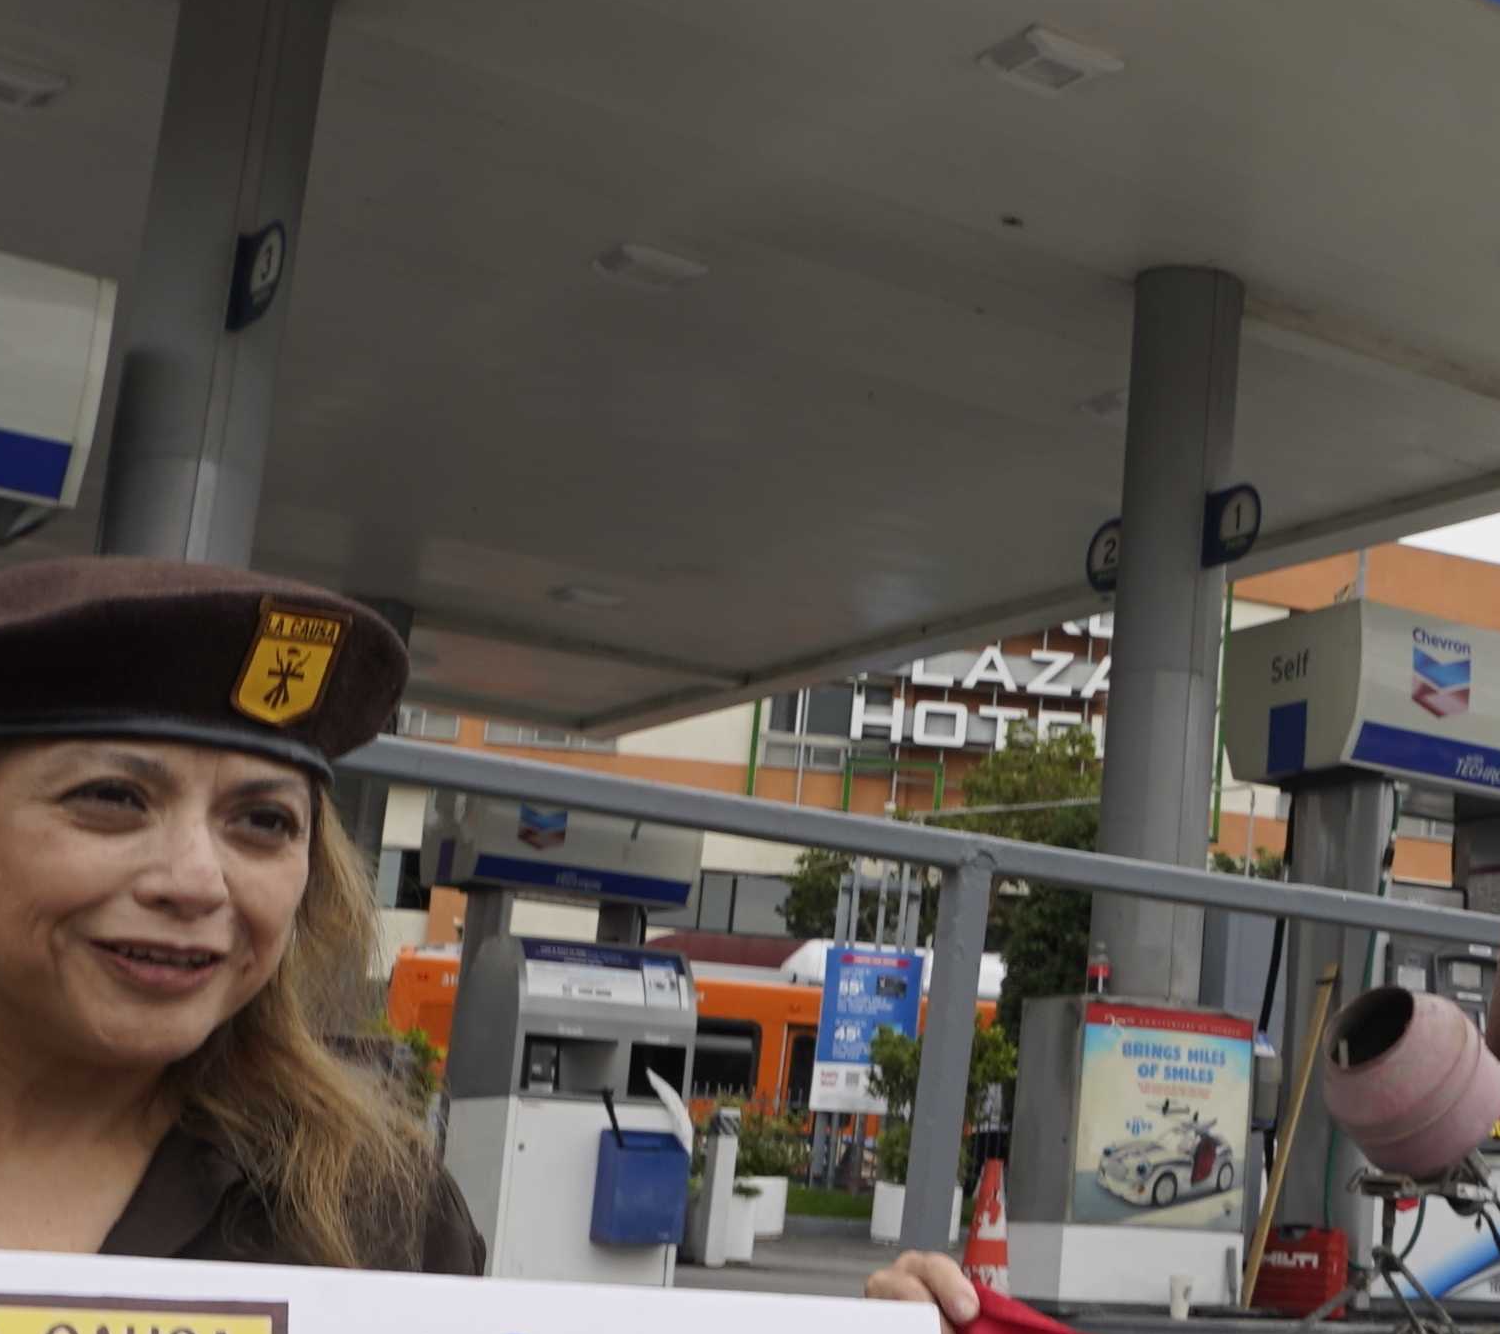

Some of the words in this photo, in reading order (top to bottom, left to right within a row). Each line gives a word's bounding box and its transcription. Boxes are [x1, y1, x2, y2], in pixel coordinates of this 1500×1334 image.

[1412, 627, 1472, 656] Chevron
[1270, 648, 1311, 685] Self
[1122, 1040, 1182, 1061] BRINGS
[1187, 1048, 1227, 1067] MILES
[1137, 1063, 1159, 1080] OF
[1163, 1065, 1215, 1084] SMILES
